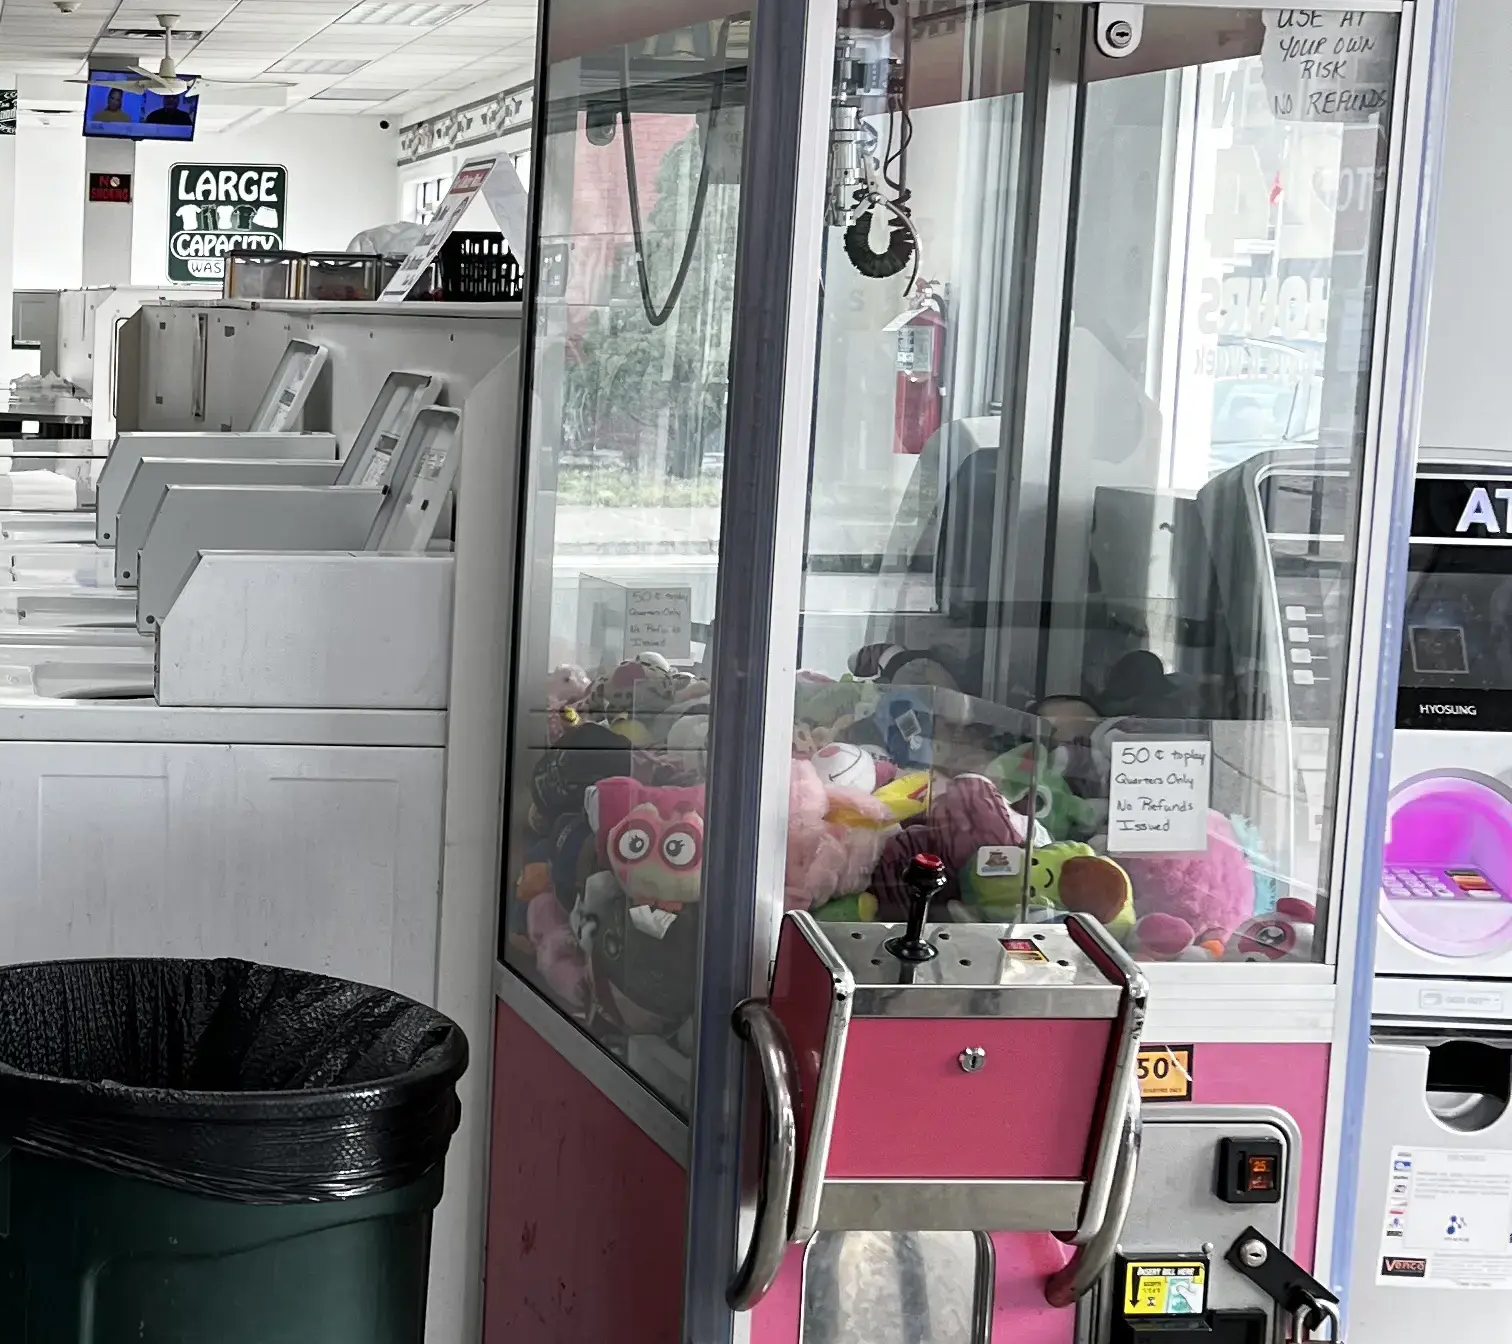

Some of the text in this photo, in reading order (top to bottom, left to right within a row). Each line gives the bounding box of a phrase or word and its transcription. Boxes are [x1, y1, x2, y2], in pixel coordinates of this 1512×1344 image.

[1276, 9, 1325, 28] USE
[1279, 35, 1376, 62] YOUR OWN
[1299, 59, 1348, 79] RISK
[1273, 88, 1388, 116] NO REFUNDS
[178, 169, 279, 202] LARGE
[176, 233, 275, 257] CAPACITY
[1419, 704, 1477, 716] HYOSUNG
[1121, 746, 1151, 765] 50
[1114, 772, 1194, 790] Quarters Only
[1116, 796, 1194, 812] No Refunds
[1116, 818, 1171, 832] Issued
